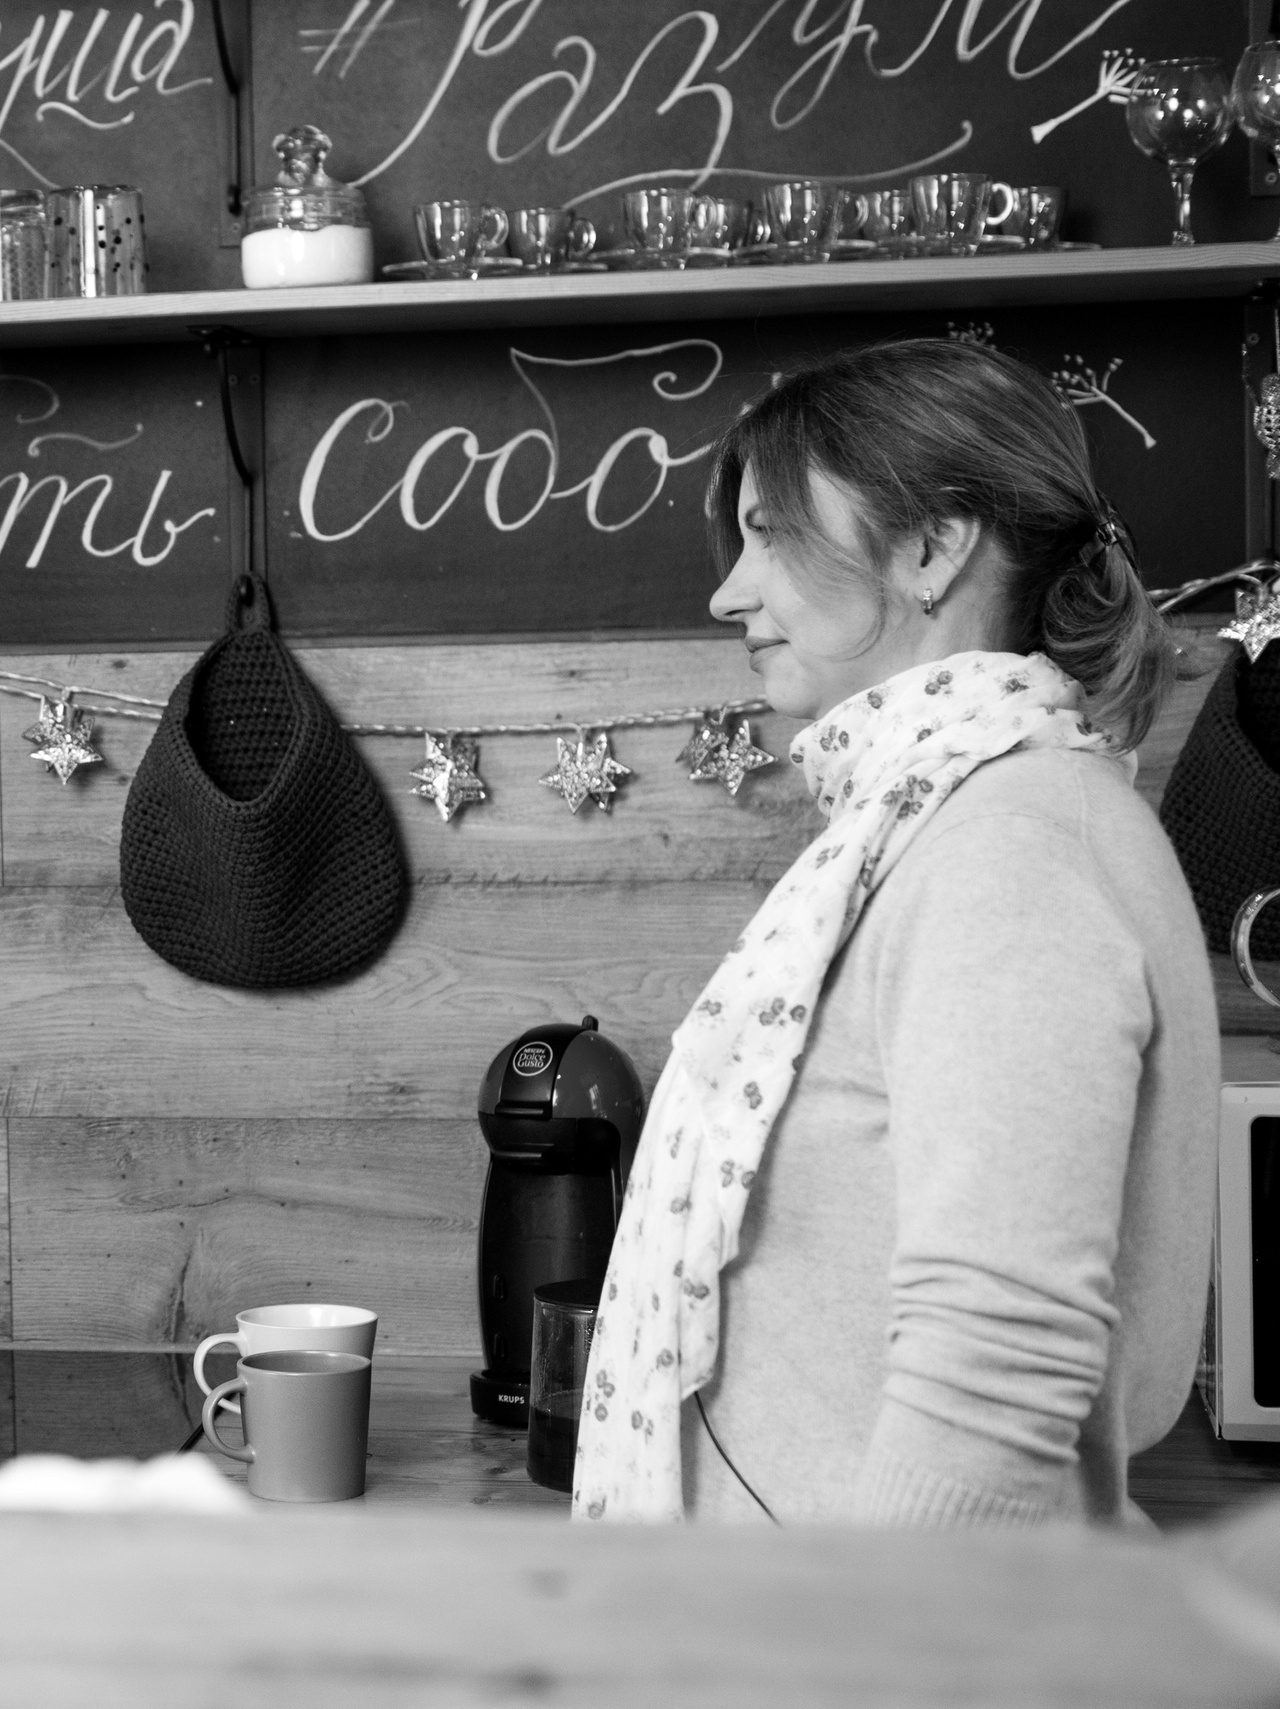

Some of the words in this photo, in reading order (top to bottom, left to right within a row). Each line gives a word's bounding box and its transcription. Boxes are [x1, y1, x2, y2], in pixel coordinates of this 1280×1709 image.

[299, 339, 722, 542] Собо
[520, 1052, 546, 1062] Dolce
[517, 1060, 544, 1068] Gusto
[498, 1394, 525, 1404] KRUPS
